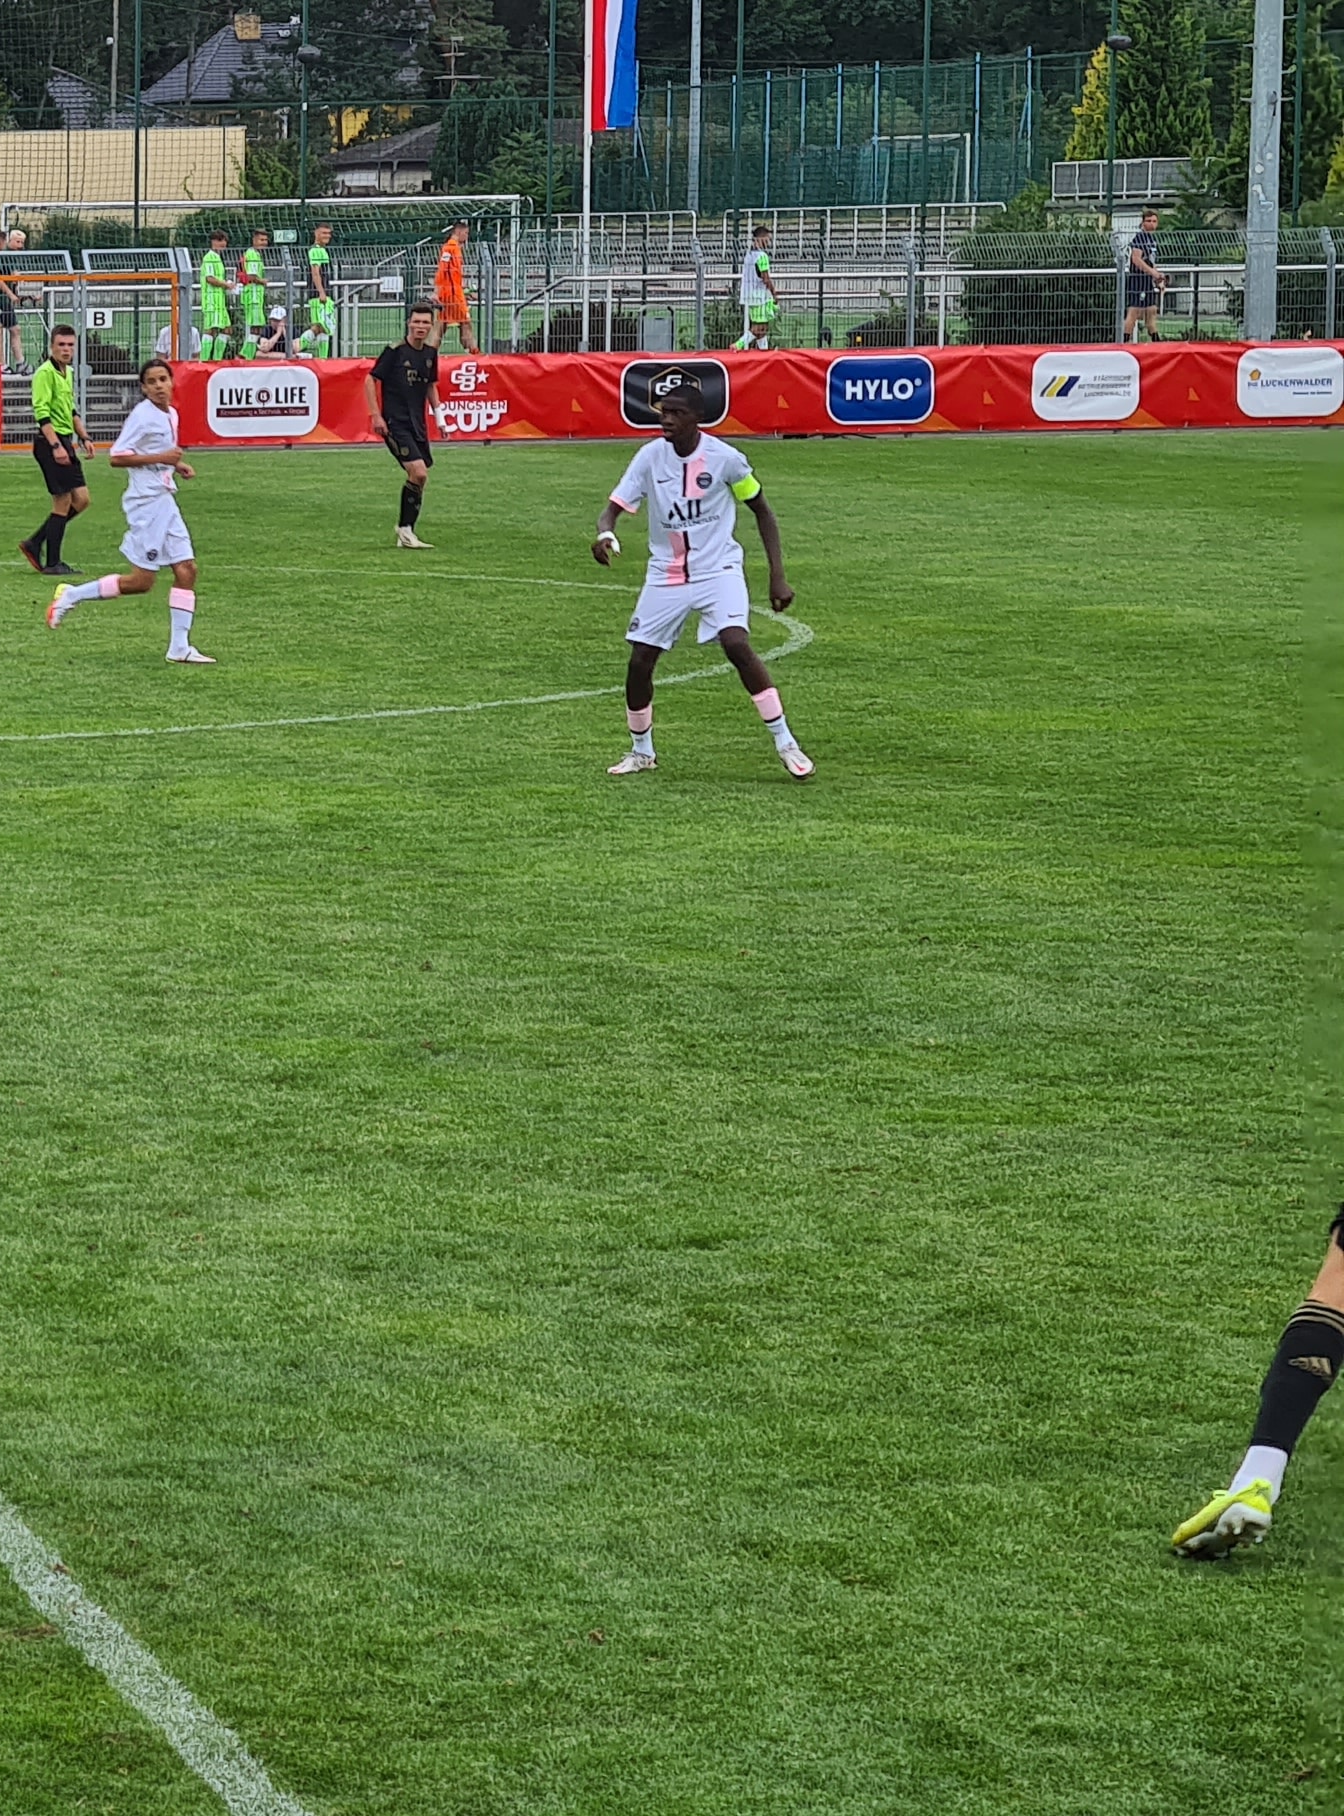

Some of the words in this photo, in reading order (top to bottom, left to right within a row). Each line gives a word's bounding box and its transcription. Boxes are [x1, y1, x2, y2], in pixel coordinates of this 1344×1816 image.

[93, 311, 106, 327] B
[845, 378, 914, 401] HYLO
[1261, 378, 1332, 388] LUCKENWALDER
[219, 388, 253, 406] LIVE
[275, 386, 307, 404] LIFE
[438, 400, 507, 412] OUNGSTER
[439, 411, 502, 433] CUP
